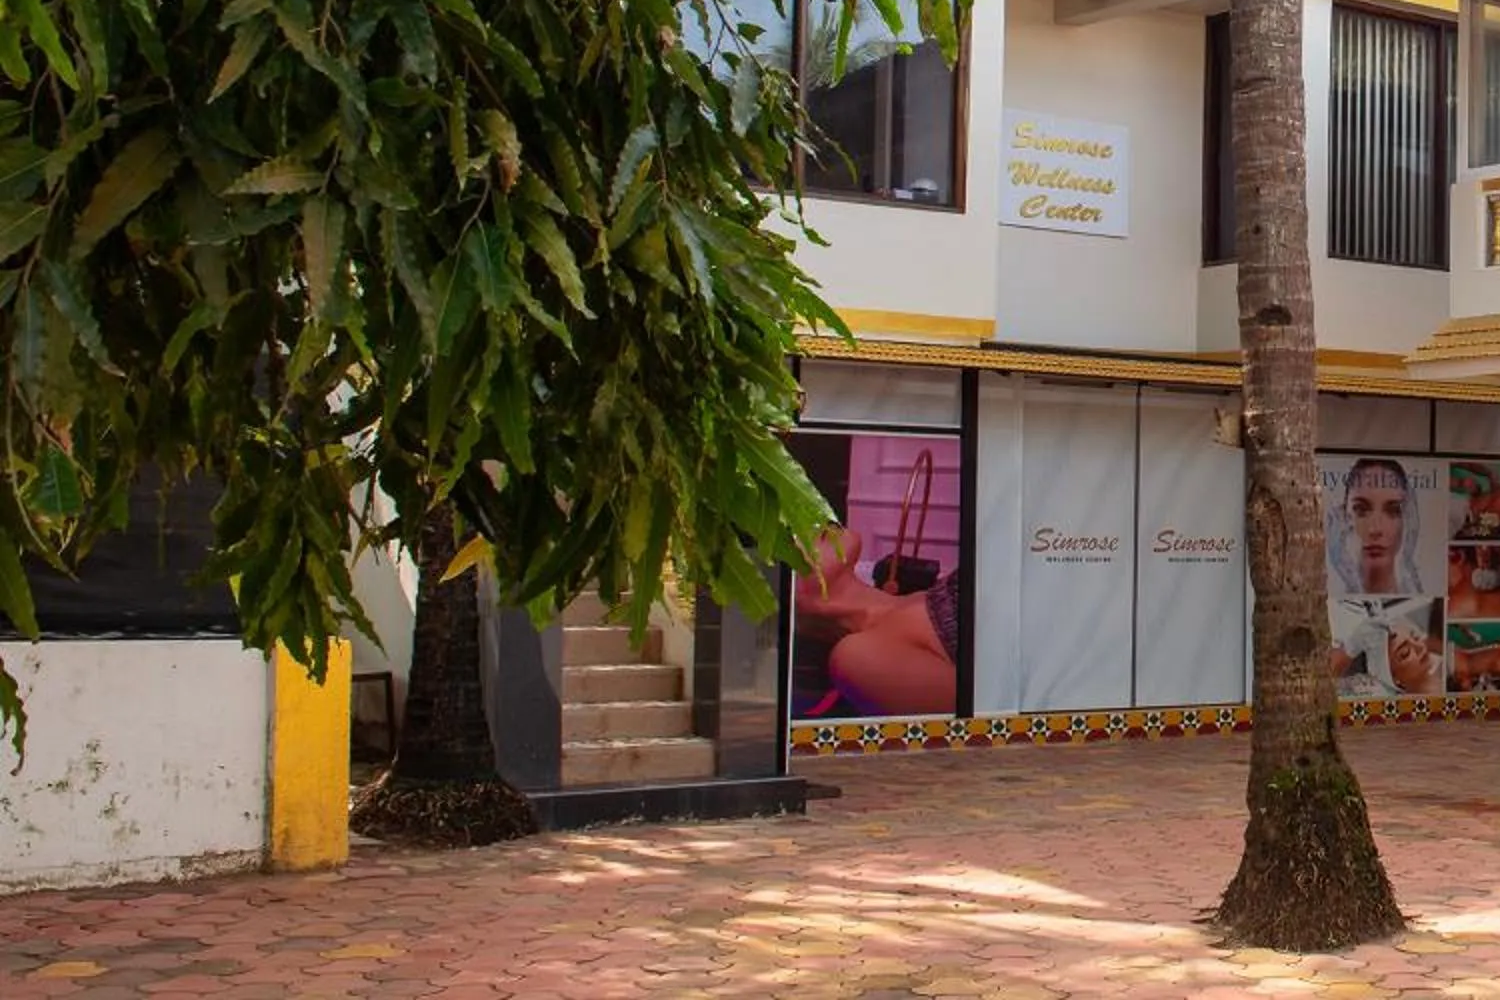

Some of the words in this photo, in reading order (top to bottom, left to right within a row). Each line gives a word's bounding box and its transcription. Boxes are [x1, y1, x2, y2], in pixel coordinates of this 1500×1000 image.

[1008, 160, 1116, 194] Wellness
[1020, 195, 1103, 222] Center
[1030, 528, 1119, 552] Simrose
[1153, 530, 1235, 553] Simrose
